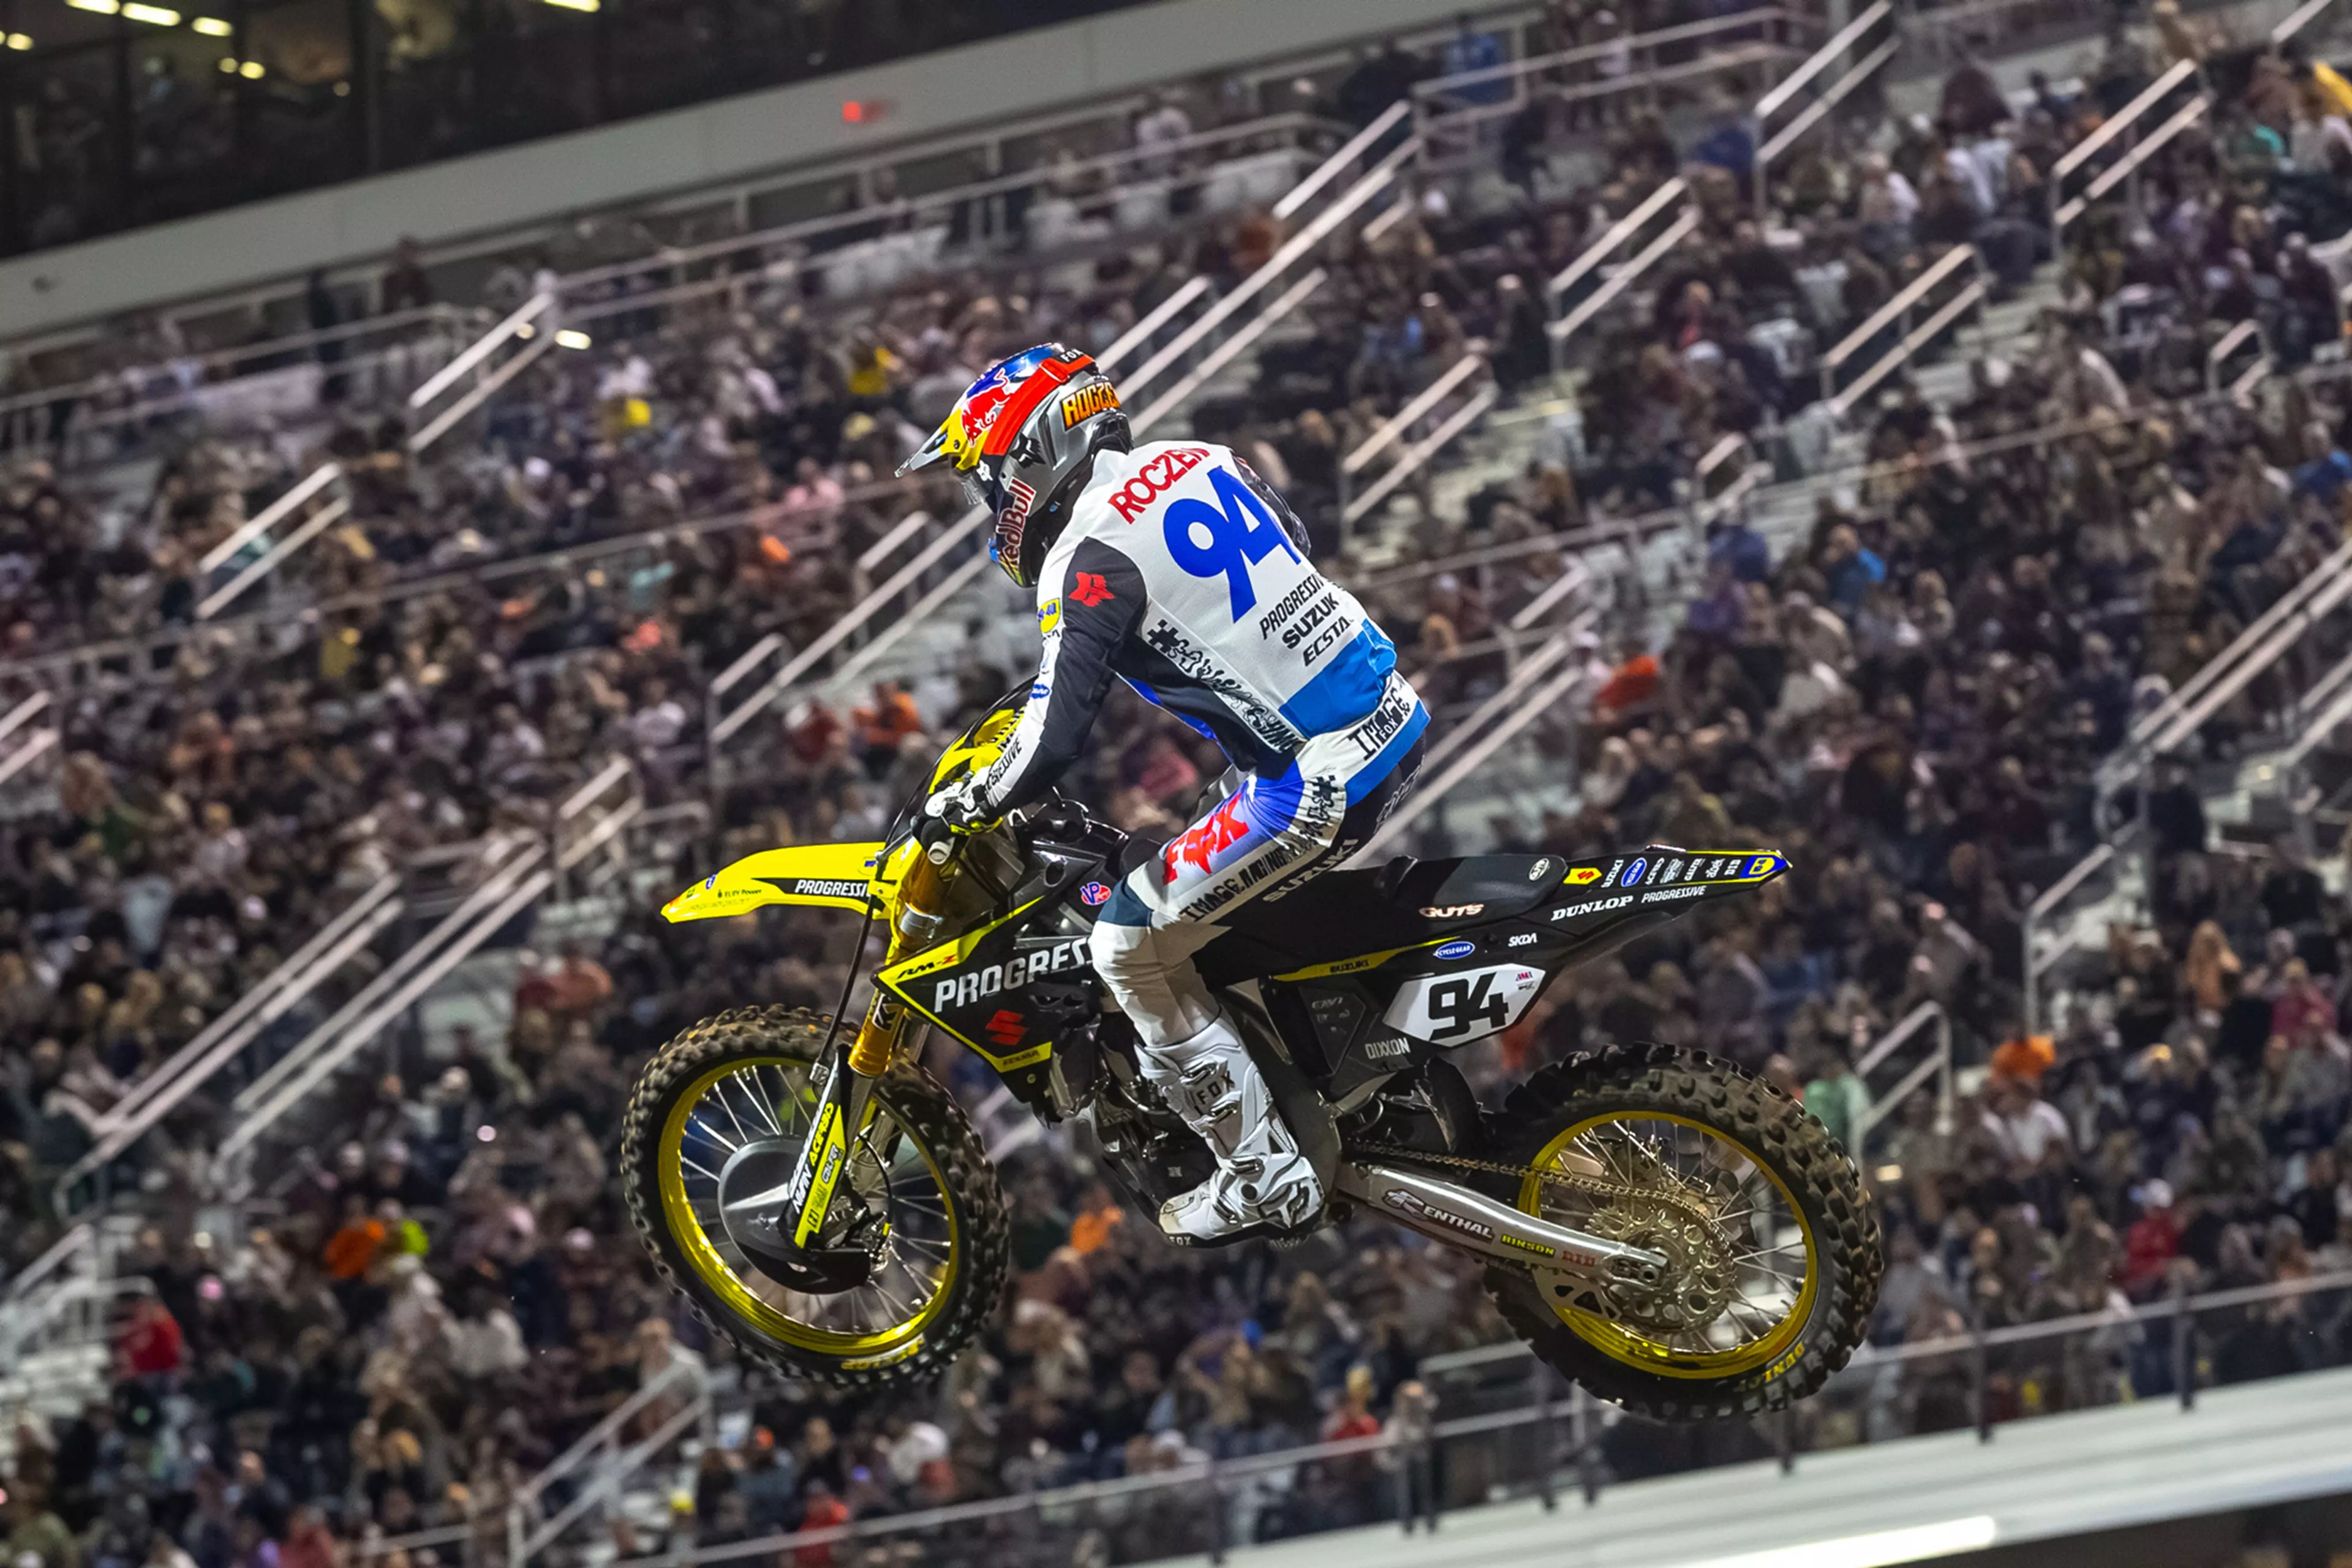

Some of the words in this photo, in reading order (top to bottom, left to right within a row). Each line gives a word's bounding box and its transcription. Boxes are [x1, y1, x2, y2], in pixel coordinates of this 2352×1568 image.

[1061, 348, 1084, 362] FOX
[1107, 448, 1210, 525] ROCZEN
[1163, 465, 1302, 624] 94
[1379, 718, 1398, 739] FOX
[1080, 881, 1100, 905] VP
[1551, 895, 1634, 921] DUNLOP
[1641, 885, 1707, 903] PROGRESSIVE
[1419, 903, 1485, 918] GUTS
[1508, 933, 1538, 947] SKDA
[1428, 971, 1509, 1041] 94
[1365, 1037, 1411, 1060] DIXXON
[1196, 1070, 1235, 1105] FOX
